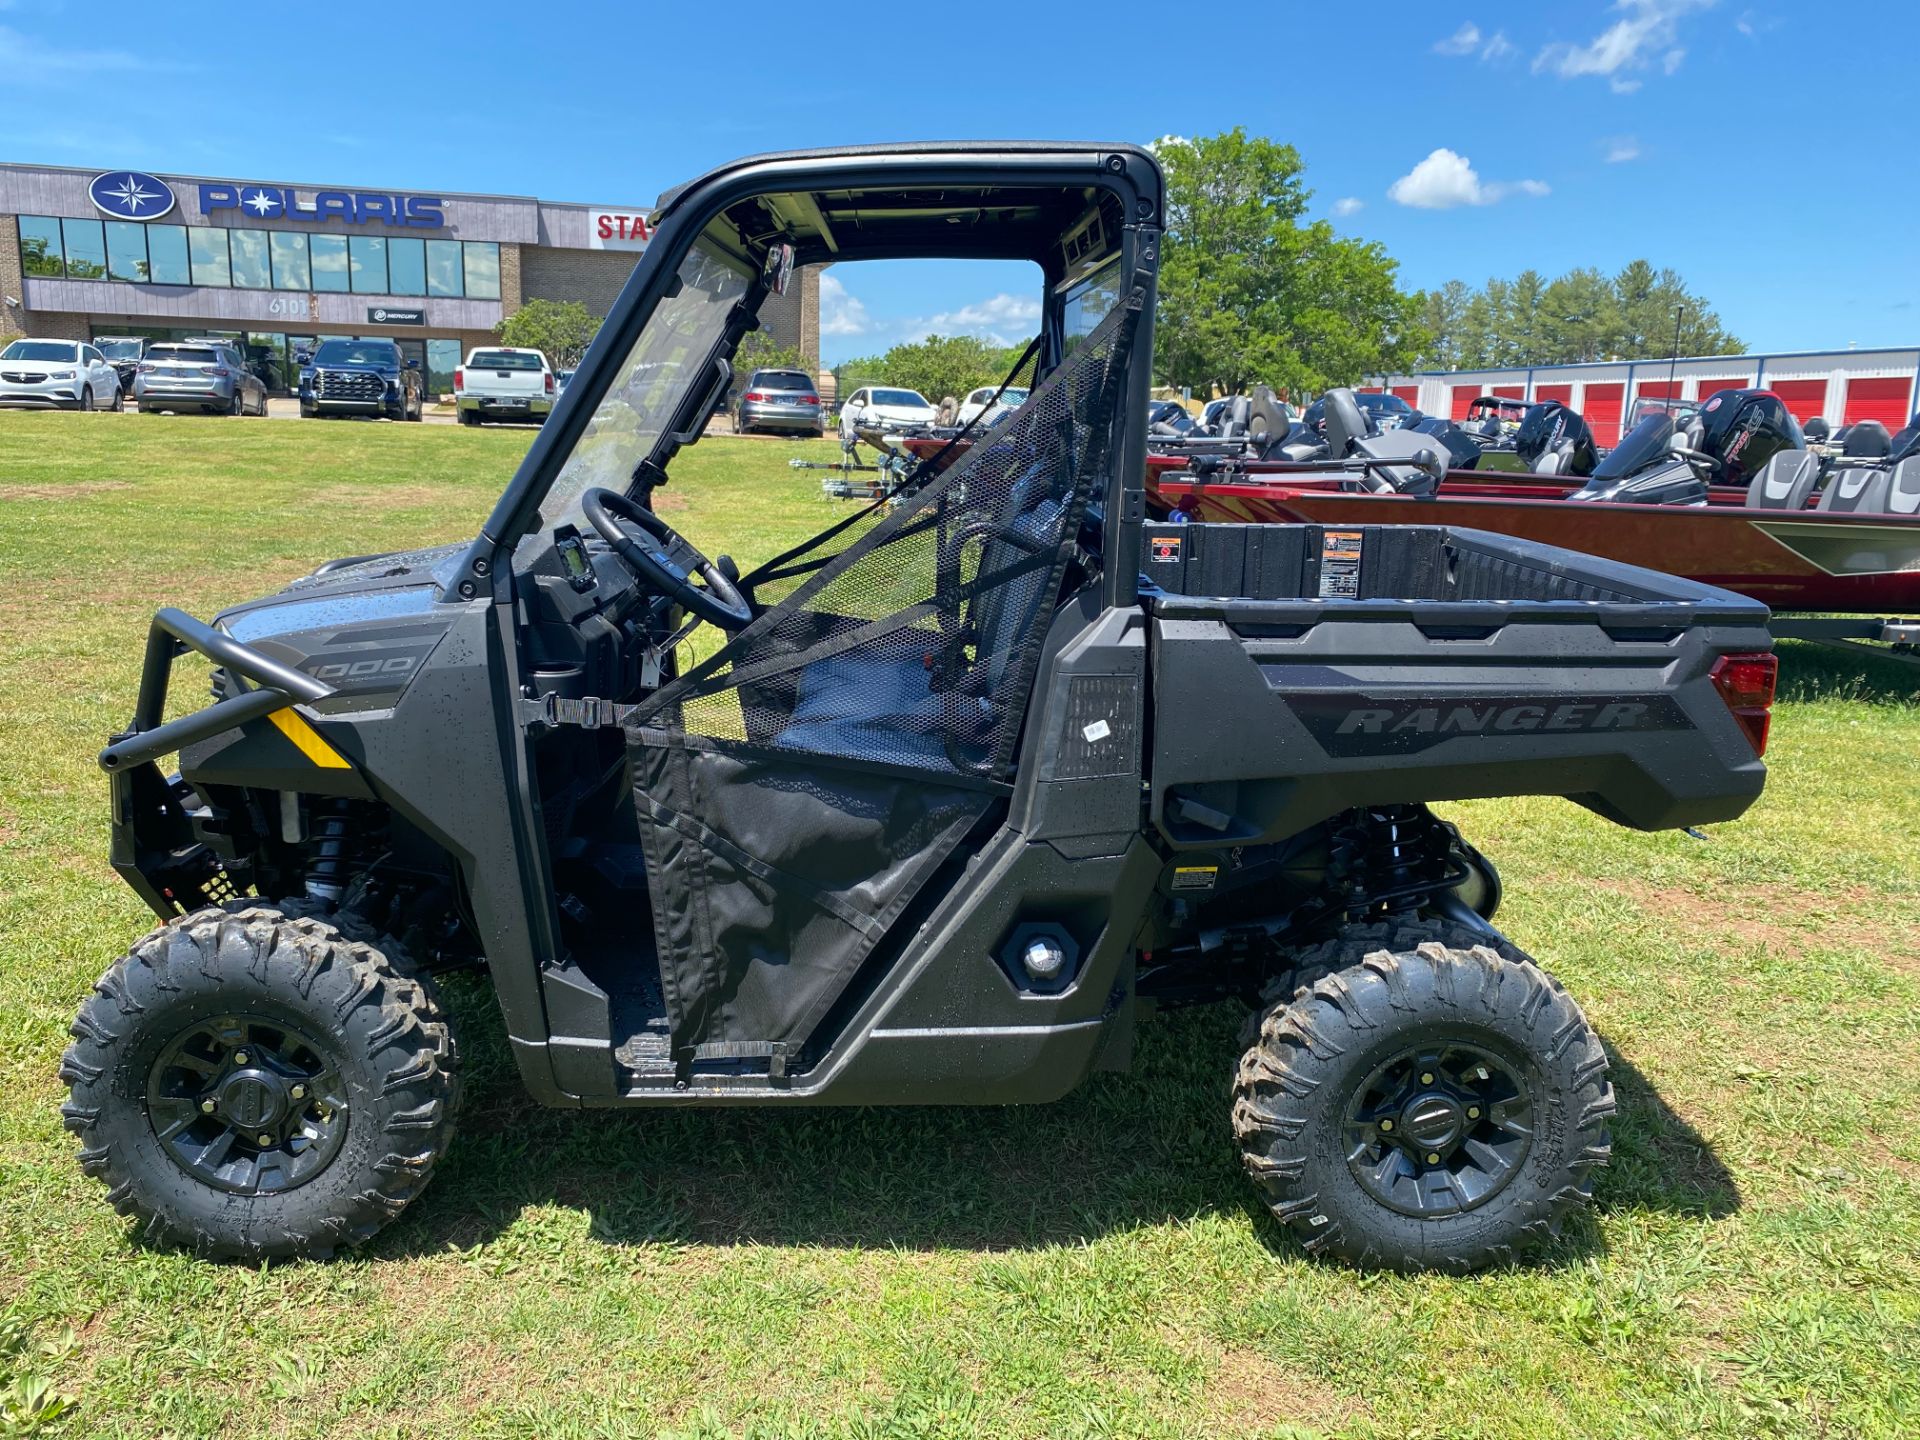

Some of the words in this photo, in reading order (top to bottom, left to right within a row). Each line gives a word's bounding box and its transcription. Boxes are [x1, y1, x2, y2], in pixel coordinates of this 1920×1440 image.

[199, 184, 444, 229] POLARIS
[597, 215, 657, 241] STA
[269, 298, 307, 315] 6101
[307, 656, 416, 679] 1000
[1335, 703, 1649, 734] RANGER
